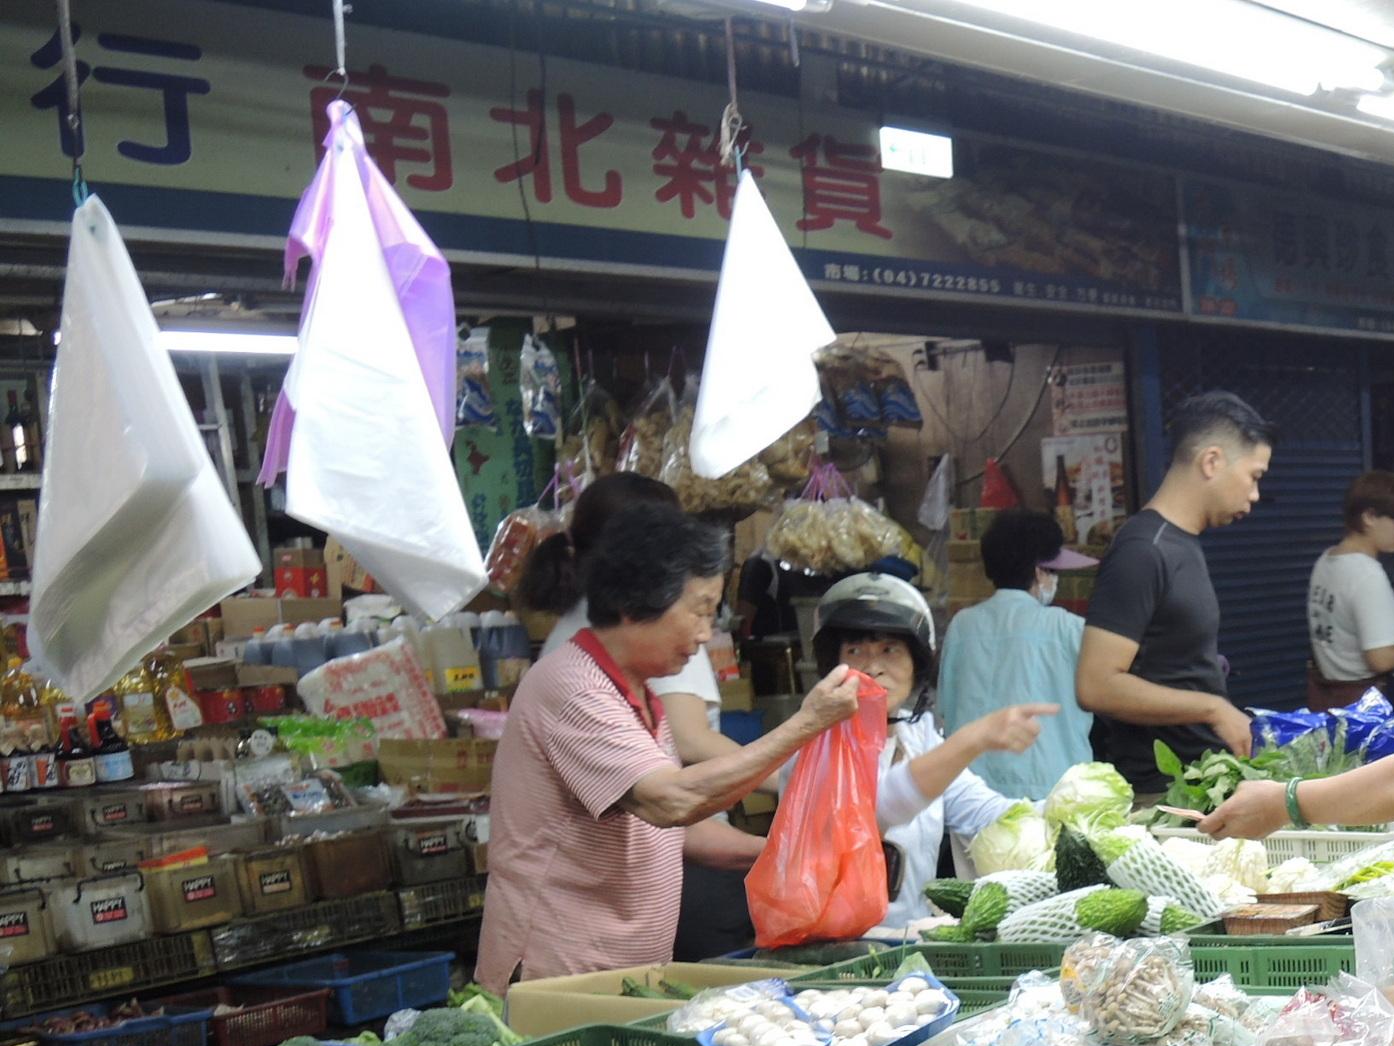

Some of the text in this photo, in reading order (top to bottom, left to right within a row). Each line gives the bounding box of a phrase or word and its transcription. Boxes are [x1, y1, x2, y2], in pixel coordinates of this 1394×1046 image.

[30, 23, 894, 241] 行 南北雜貨
[420, 836, 447, 849] HAPPY
[183, 877, 212, 892] HAPPY
[262, 872, 289, 885] HAPPY
[93, 898, 123, 914] HAPPY
[0, 912, 25, 927] APPY
